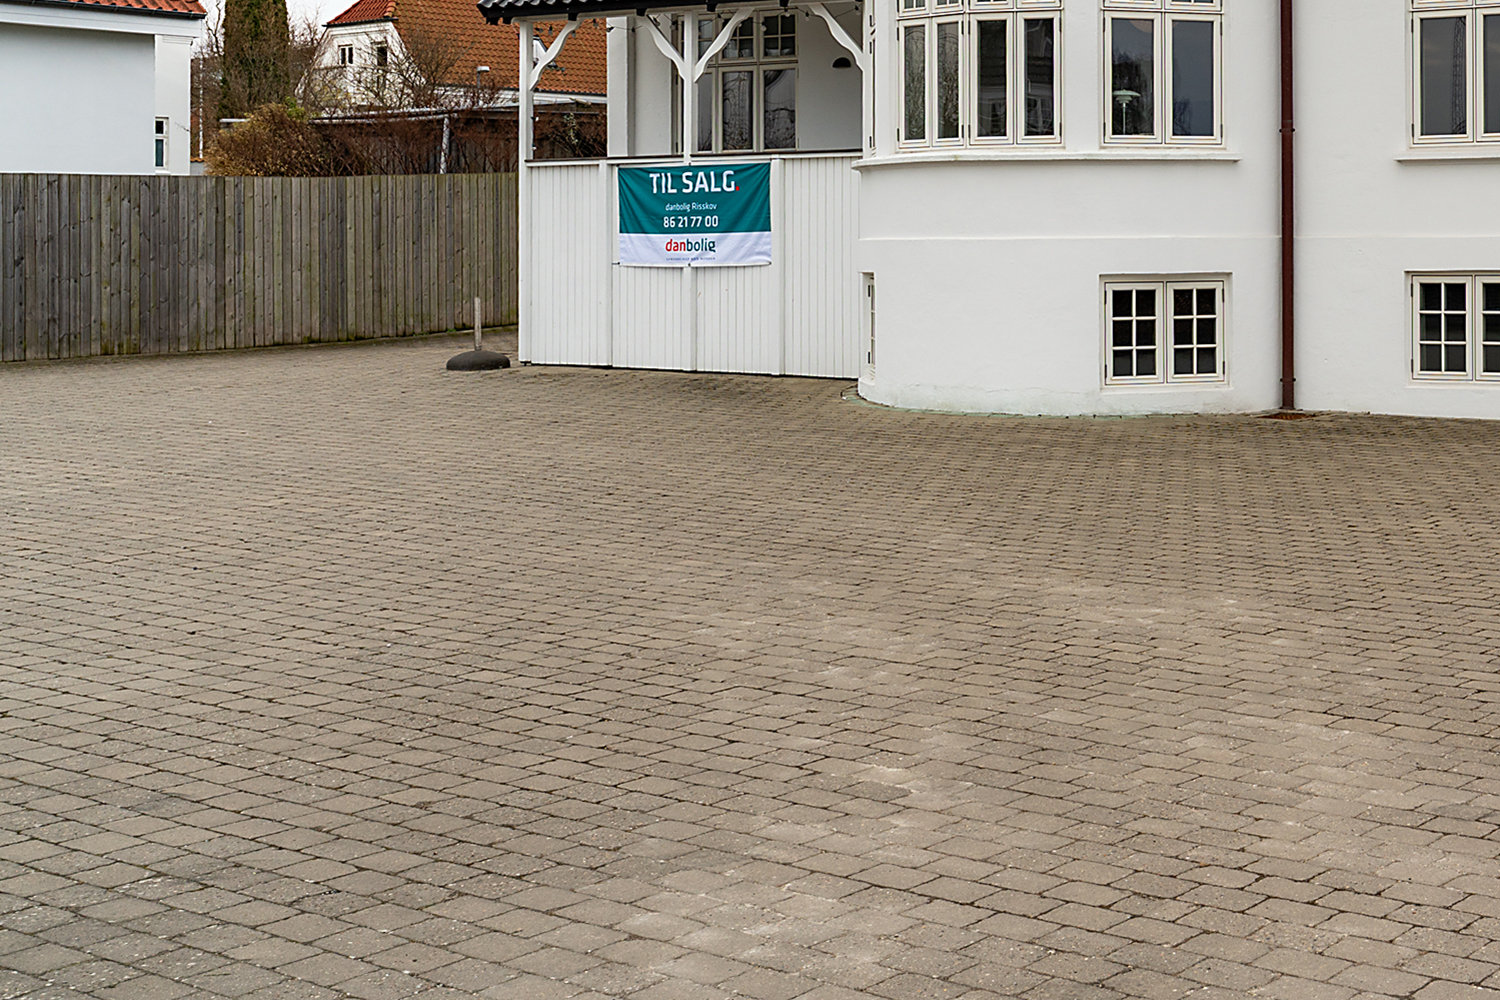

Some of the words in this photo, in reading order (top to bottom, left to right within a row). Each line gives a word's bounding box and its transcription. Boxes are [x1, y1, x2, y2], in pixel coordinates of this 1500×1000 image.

[649, 172, 677, 194] TIL
[682, 170, 740, 193] SALG.
[665, 203, 691, 212] danbolig
[691, 201, 717, 210] Risskov
[663, 216, 676, 228] 86
[678, 216, 688, 228] 21
[690, 216, 702, 228] 77
[704, 215, 719, 228] 00
[665, 238, 716, 253] danbolig
